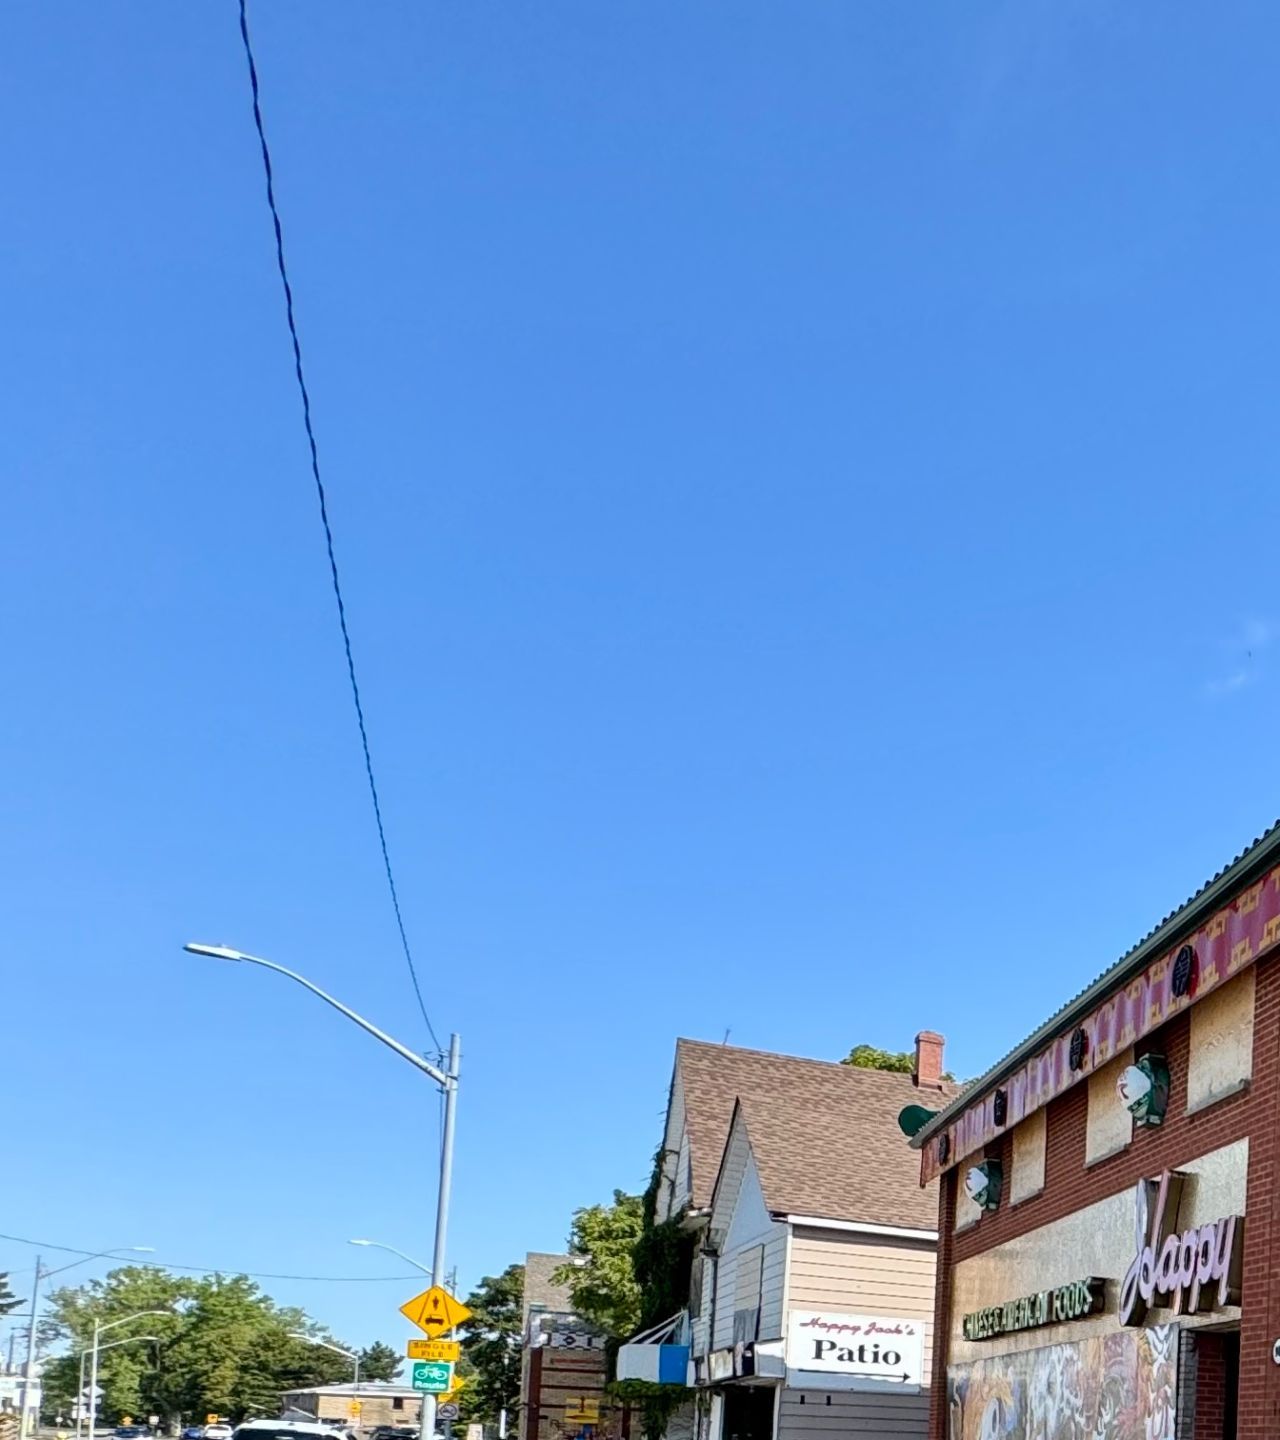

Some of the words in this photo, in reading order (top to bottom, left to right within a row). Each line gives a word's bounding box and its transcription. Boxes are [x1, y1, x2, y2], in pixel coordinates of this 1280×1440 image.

[1119, 1169, 1239, 1327] Happy
[1052, 1277, 1094, 1321] FOODS
[799, 1317, 862, 1336] Happy
[864, 1321, 916, 1336] Jack's
[811, 1338, 902, 1366] Patio
[414, 1380, 447, 1390] Route
